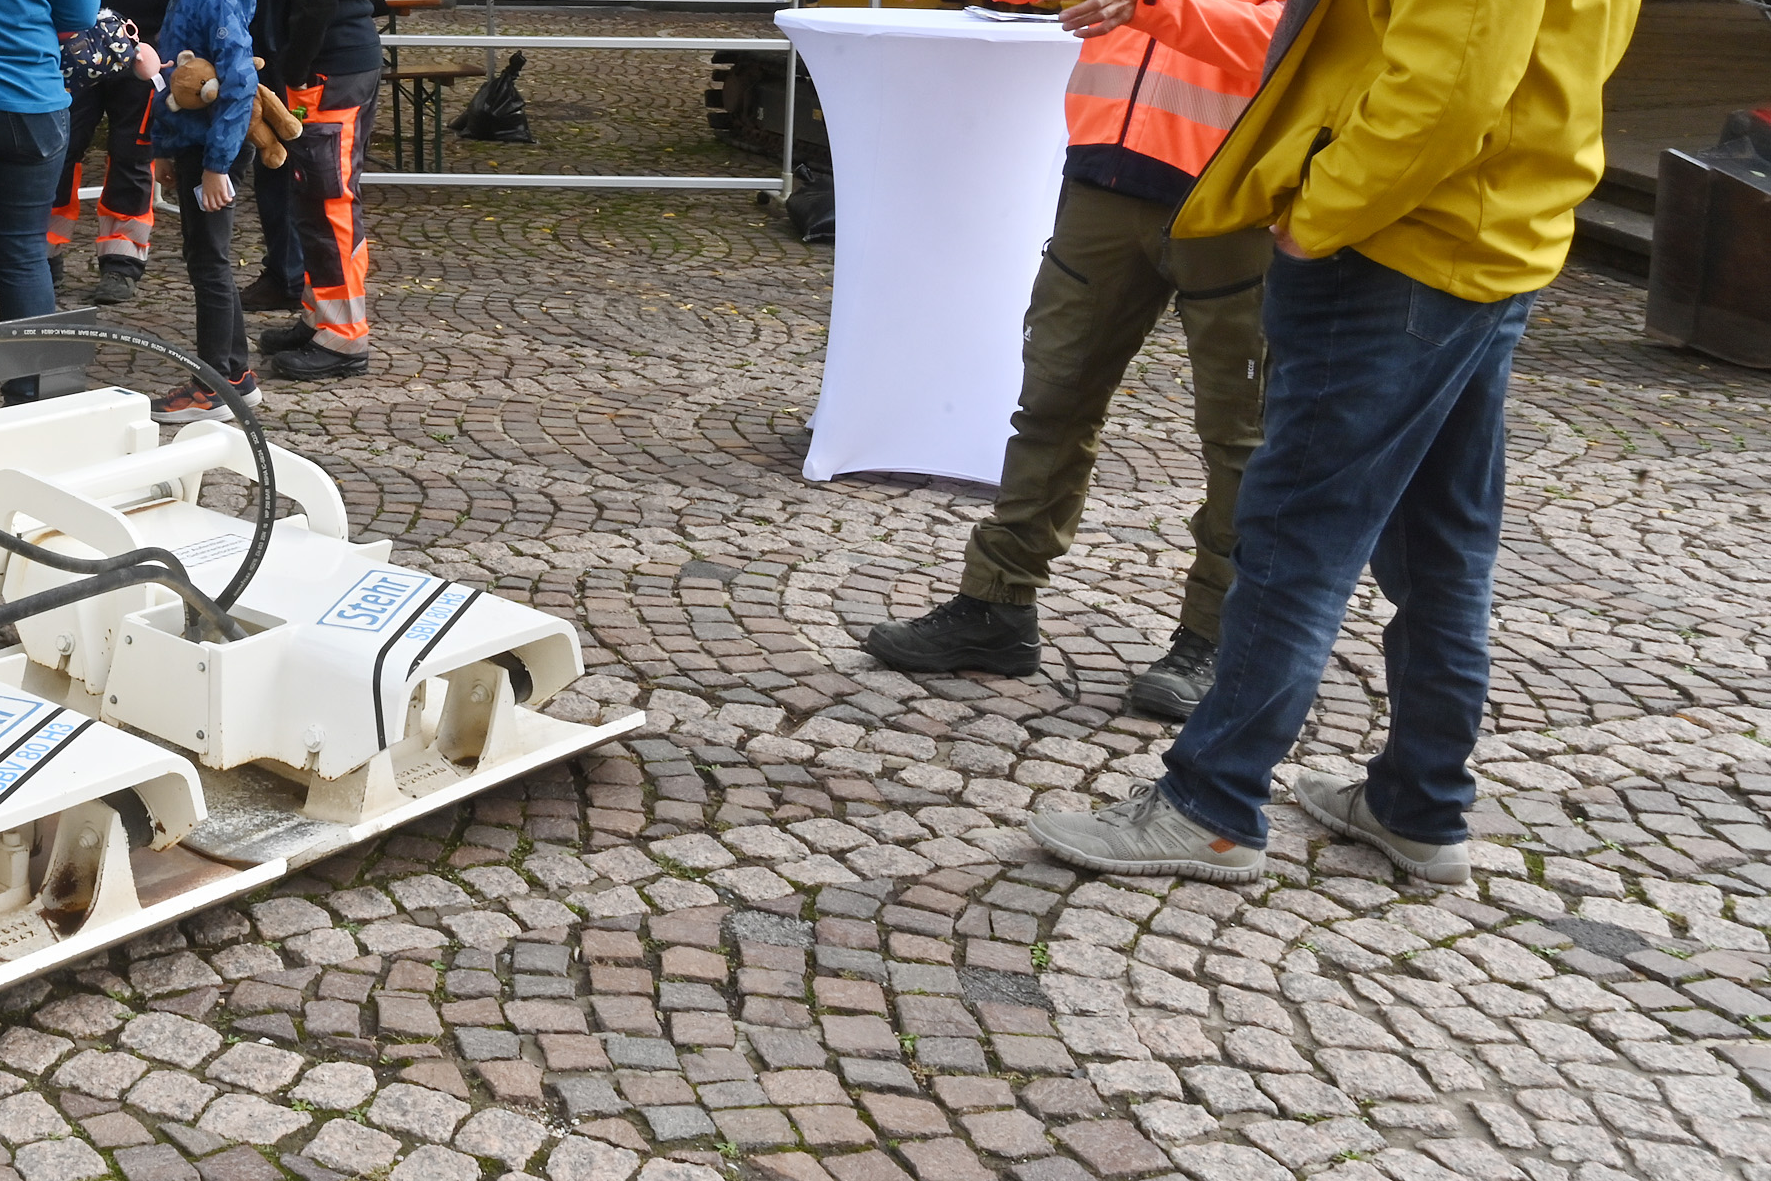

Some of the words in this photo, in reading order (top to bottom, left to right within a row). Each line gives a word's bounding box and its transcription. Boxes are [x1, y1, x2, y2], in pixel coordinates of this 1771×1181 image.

[337, 577, 410, 626] Stehr
[405, 619, 440, 641] SBV
[425, 607, 452, 620] 80
[440, 592, 466, 607] H3
[15, 743, 50, 761] 80
[42, 723, 75, 742] H3
